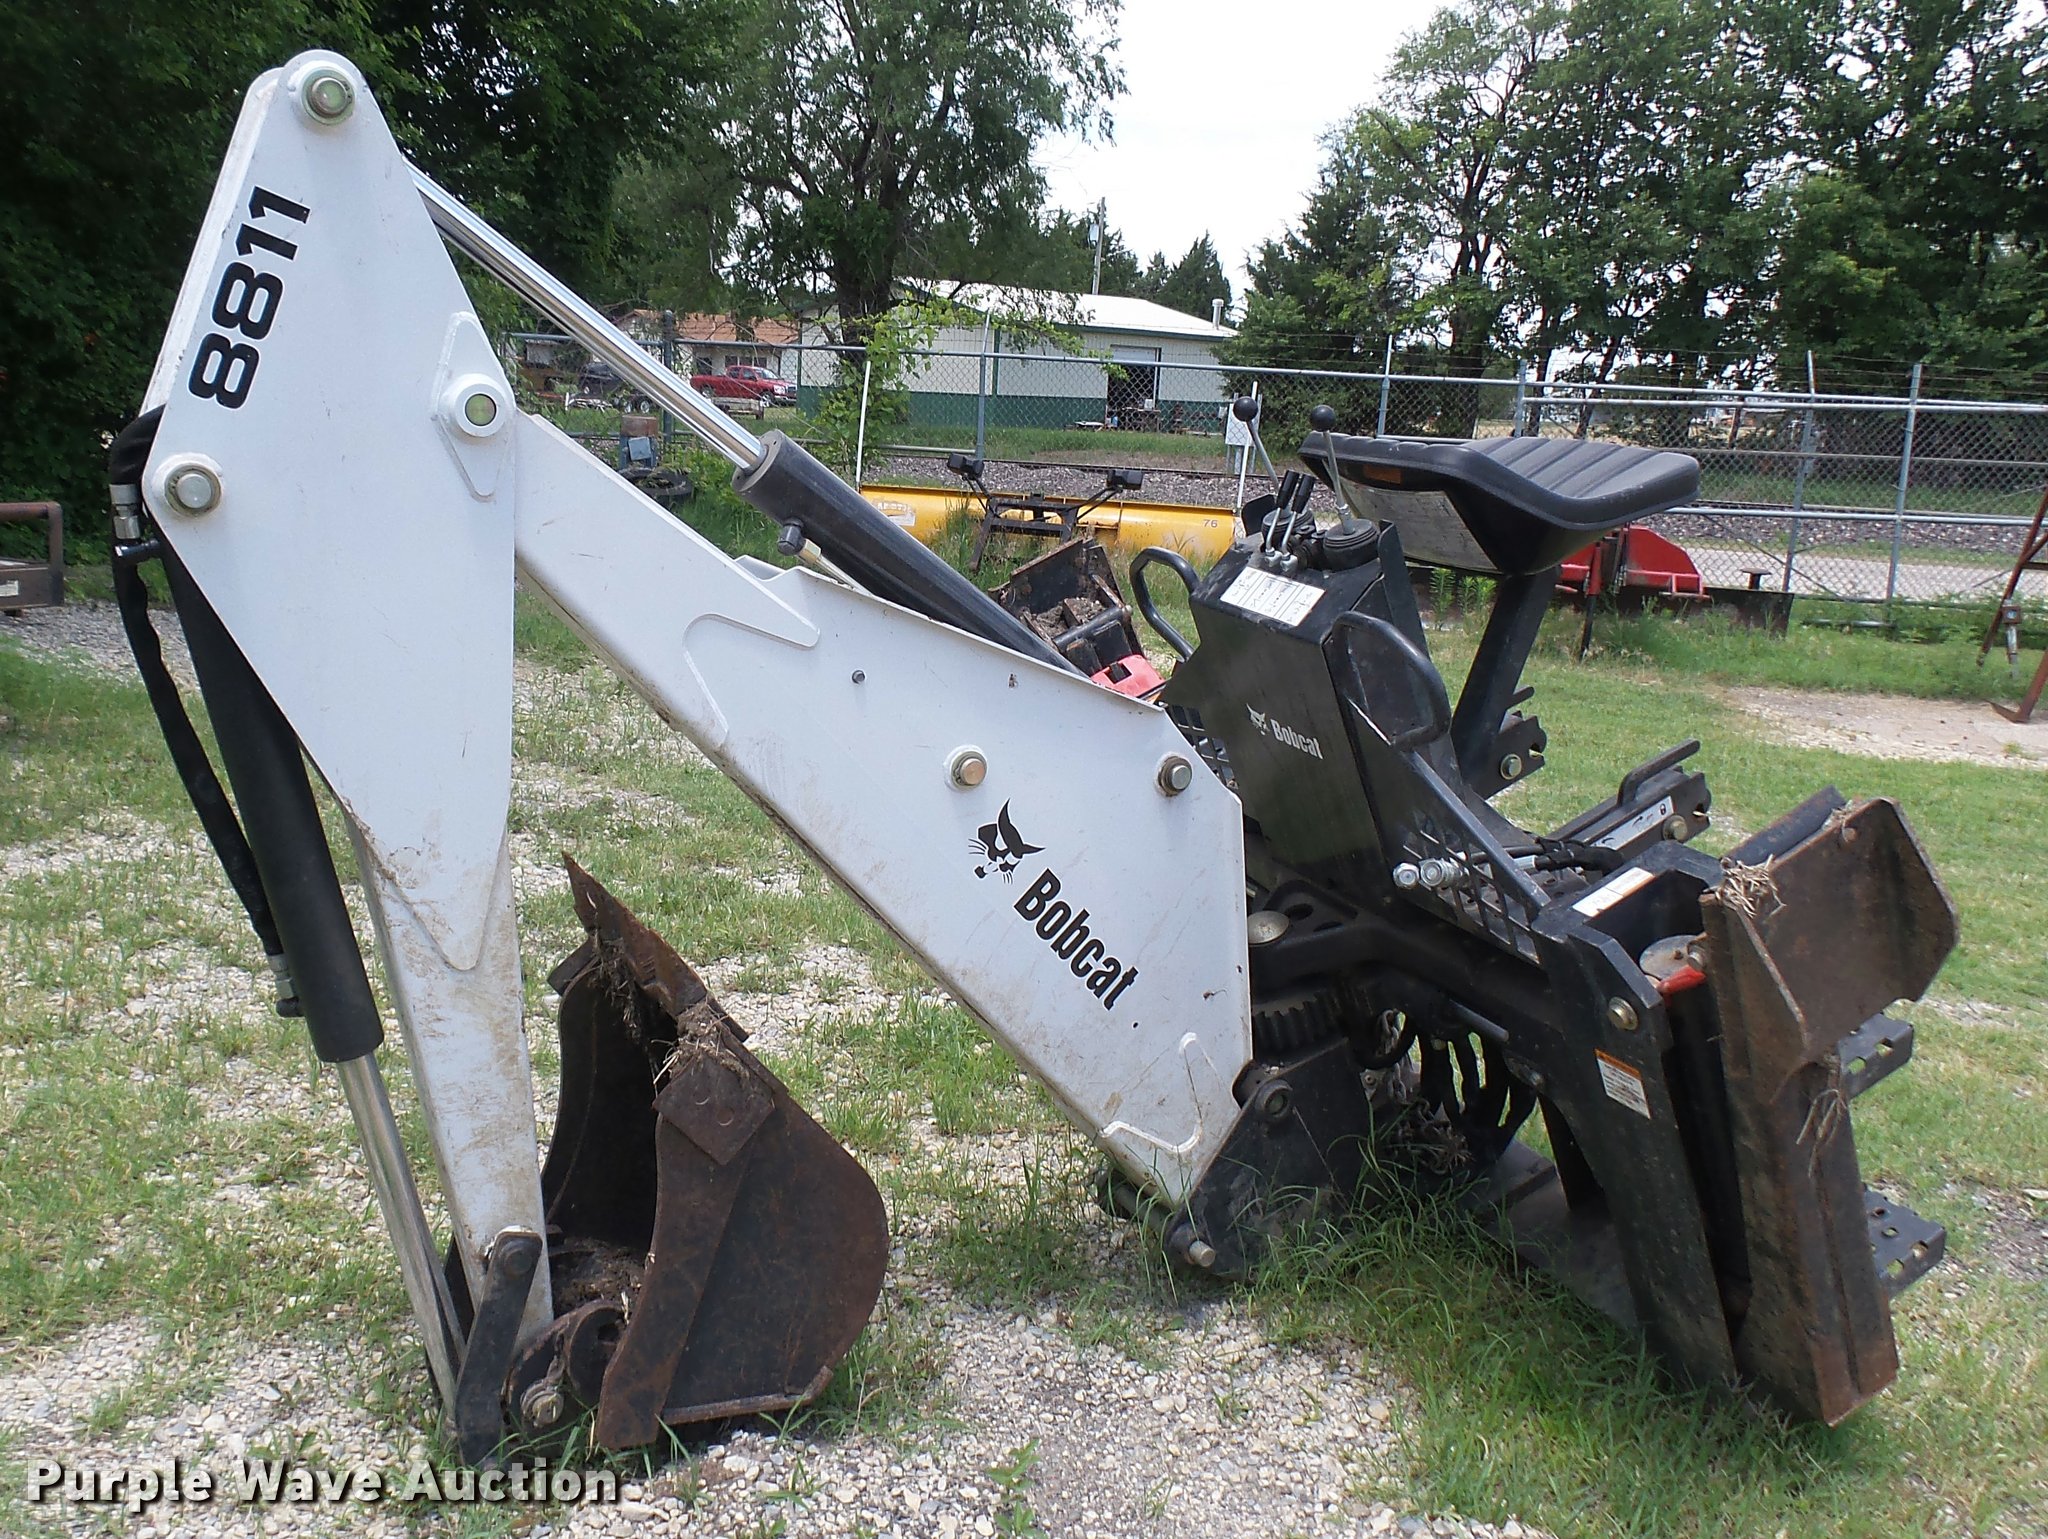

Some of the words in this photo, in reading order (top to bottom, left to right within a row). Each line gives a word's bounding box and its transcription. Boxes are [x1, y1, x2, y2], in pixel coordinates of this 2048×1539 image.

[187, 185, 311, 410] 8811
[1203, 519, 1218, 528] 76
[1269, 718, 1324, 760] Bobcat
[1013, 867, 1140, 1011] Bobcat
